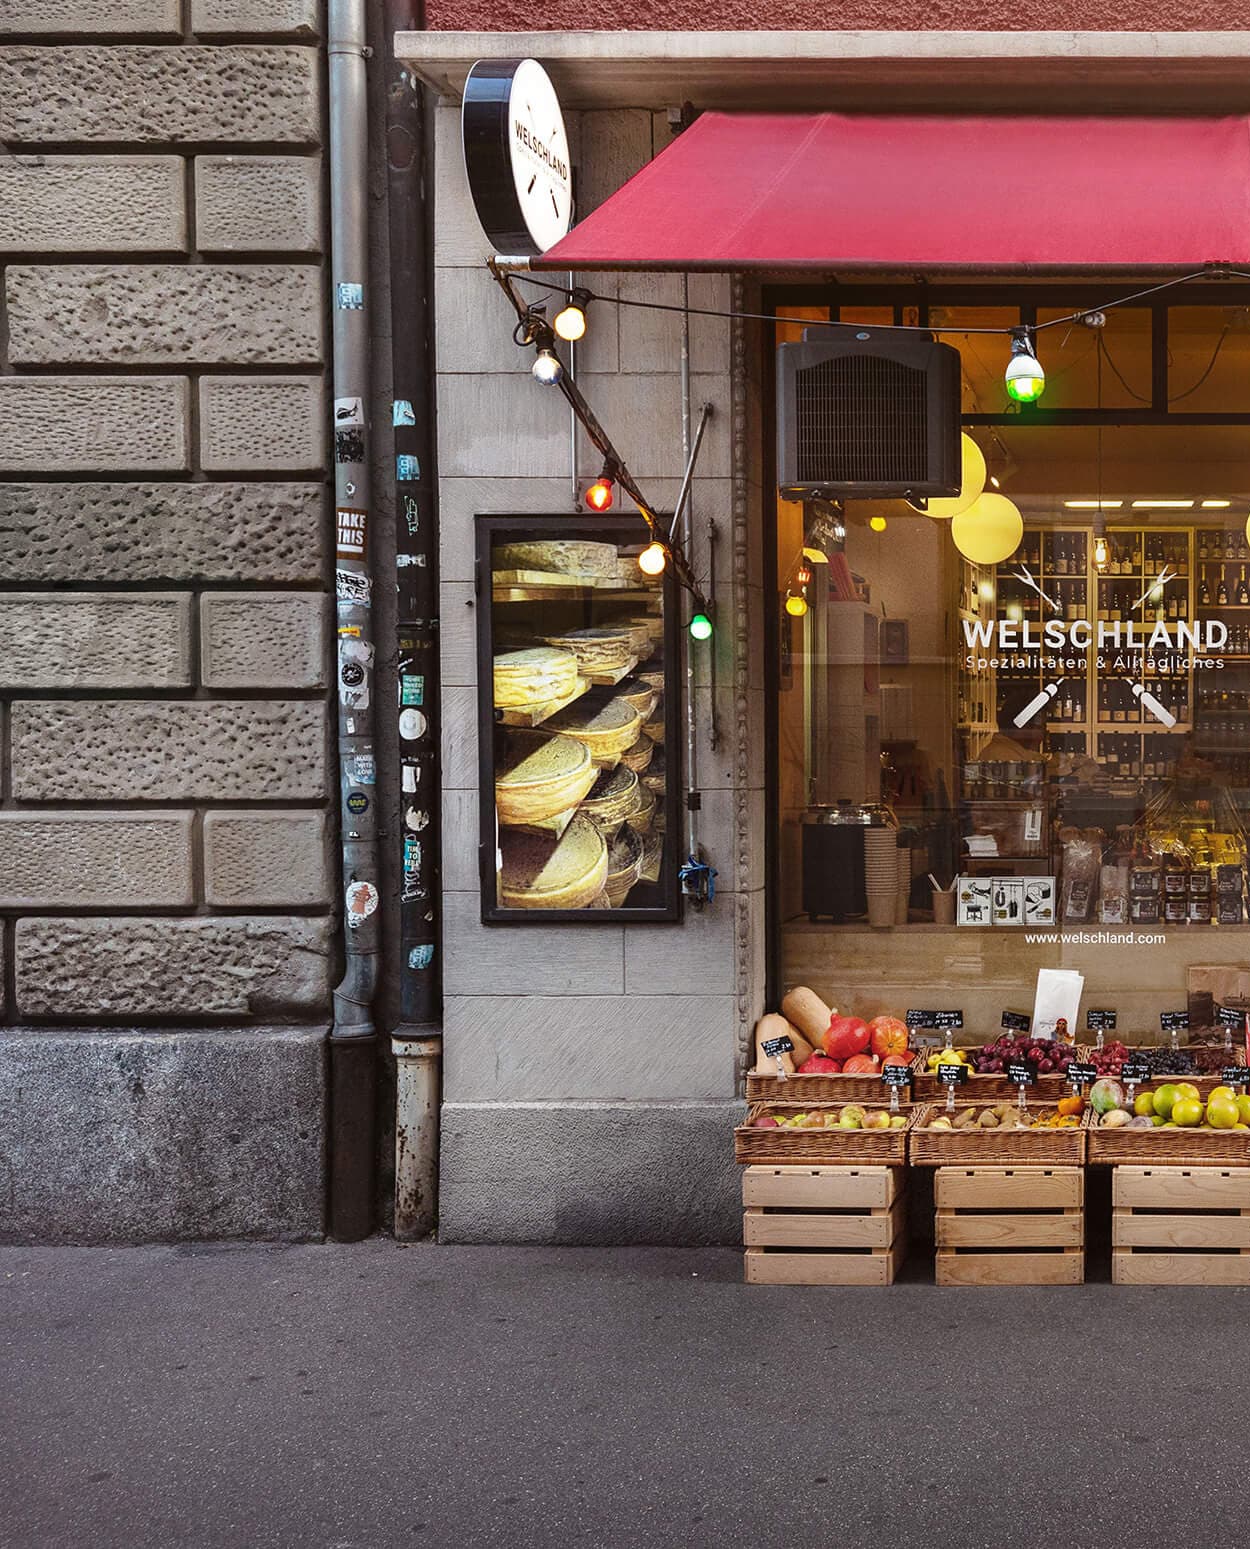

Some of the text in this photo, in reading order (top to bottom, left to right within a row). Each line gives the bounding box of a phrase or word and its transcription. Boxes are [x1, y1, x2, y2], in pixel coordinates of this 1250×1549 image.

[515, 120, 567, 180] WELSCHLAND
[337, 511, 366, 529] TAKE
[337, 528, 364, 545] THIS
[962, 619, 1229, 649] WELSCHLAND
[966, 655, 1225, 673] Spezialitäten & Alltägliches
[1025, 931, 1166, 945] www.welschland.com
